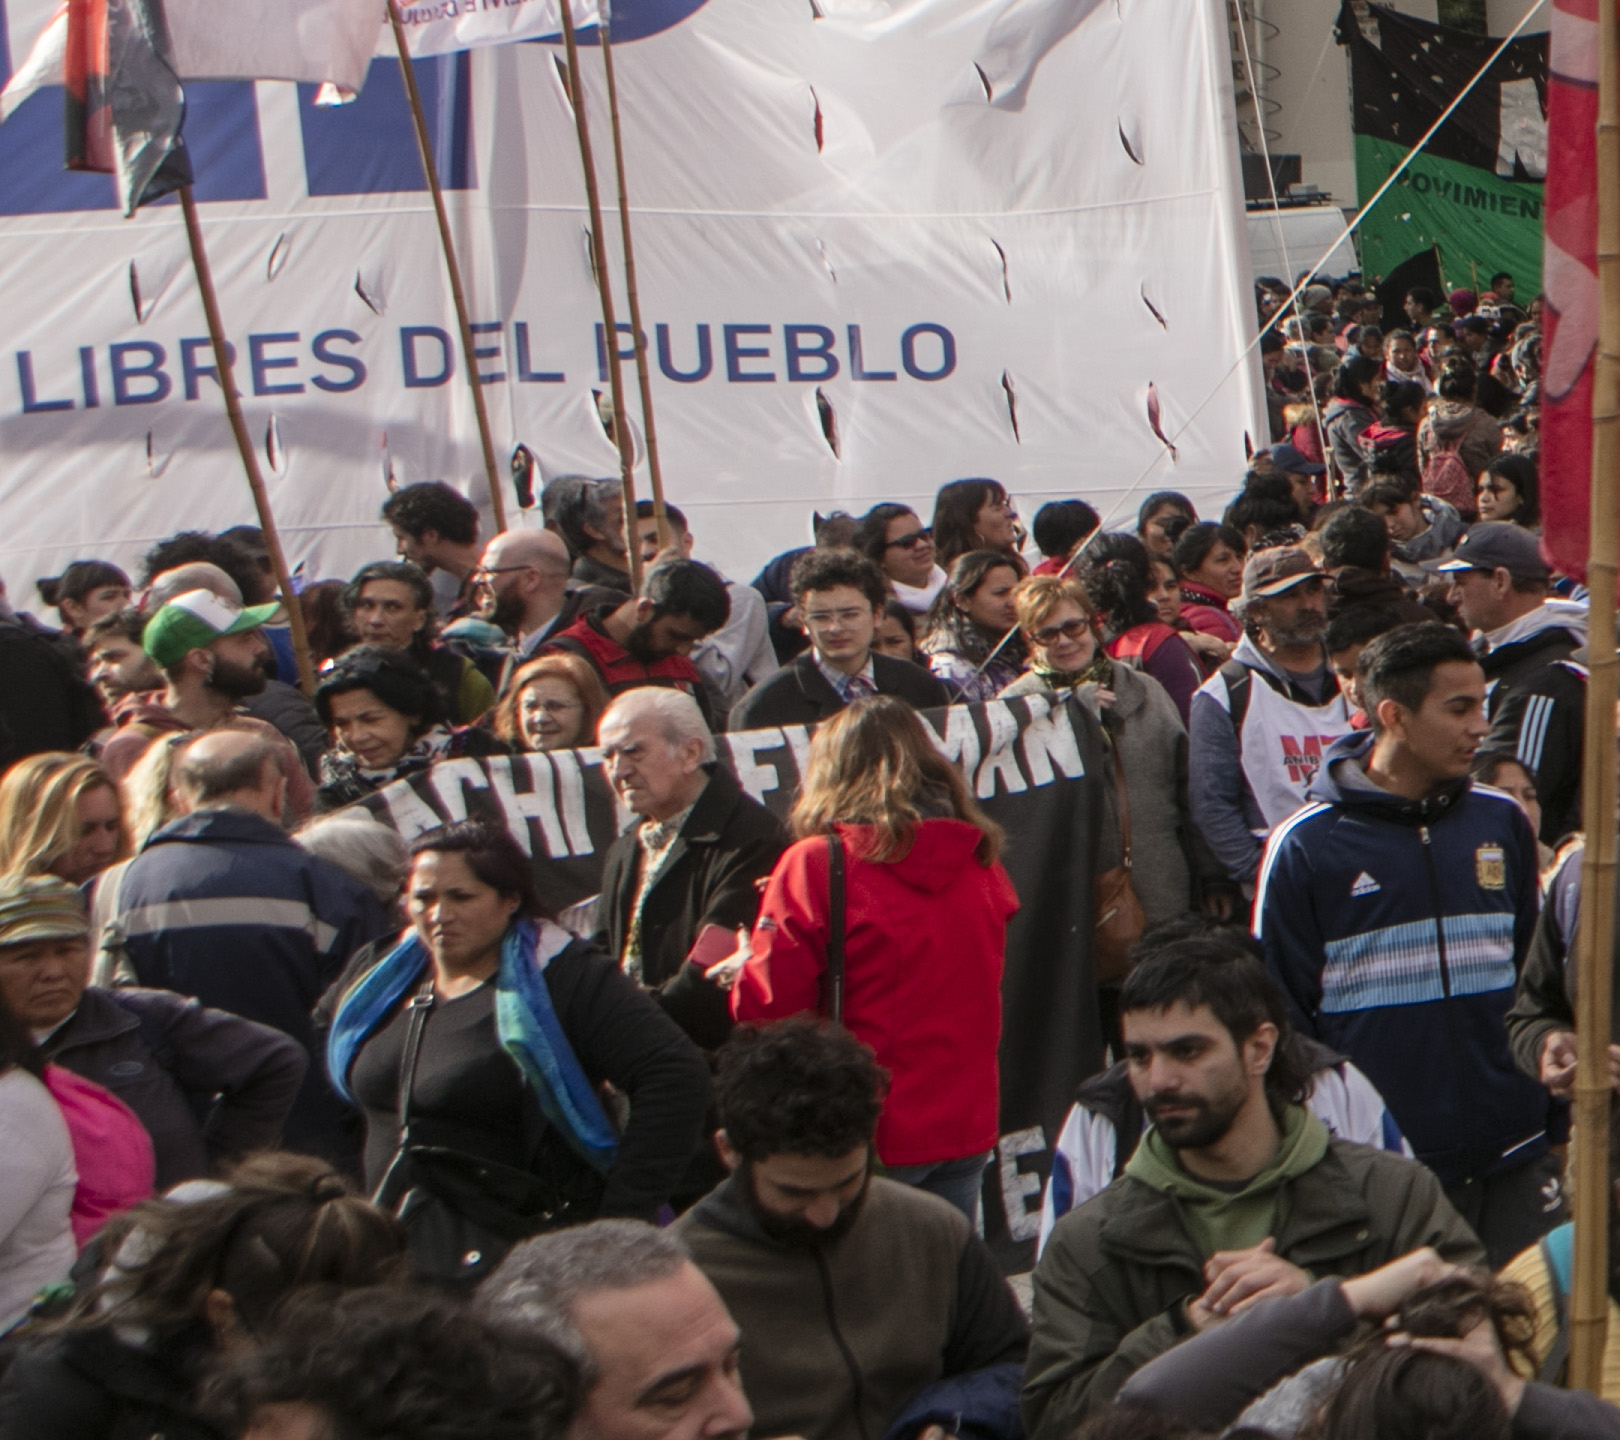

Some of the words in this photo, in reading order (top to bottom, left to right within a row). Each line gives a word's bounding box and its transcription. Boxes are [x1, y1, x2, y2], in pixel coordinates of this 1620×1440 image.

[1389, 162, 1543, 221] MOVIMIEN
[16, 328, 368, 415] LIBRES
[399, 320, 565, 390] DEL
[594, 322, 958, 385] PUEBLO
